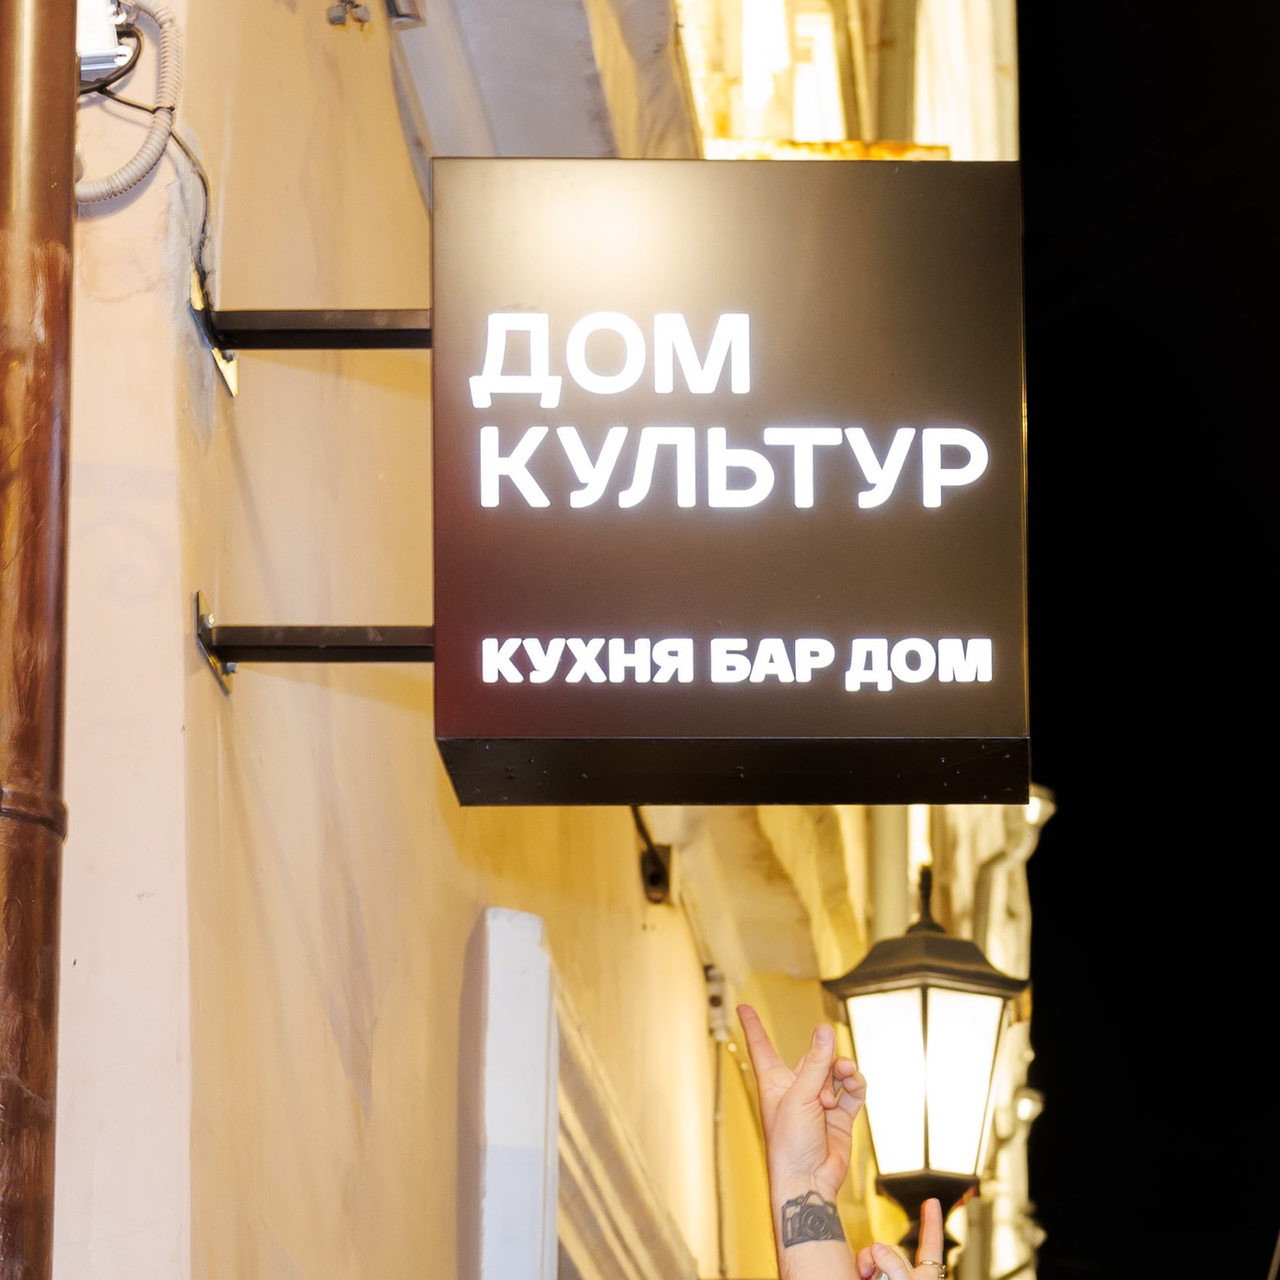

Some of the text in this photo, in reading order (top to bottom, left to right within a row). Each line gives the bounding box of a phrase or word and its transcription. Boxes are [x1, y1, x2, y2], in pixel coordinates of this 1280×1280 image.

[468, 310, 751, 408] ДОМ
[479, 425, 989, 509] КУЛЬТУР
[482, 637, 993, 692] КУХНЯ БАР ДОМ
